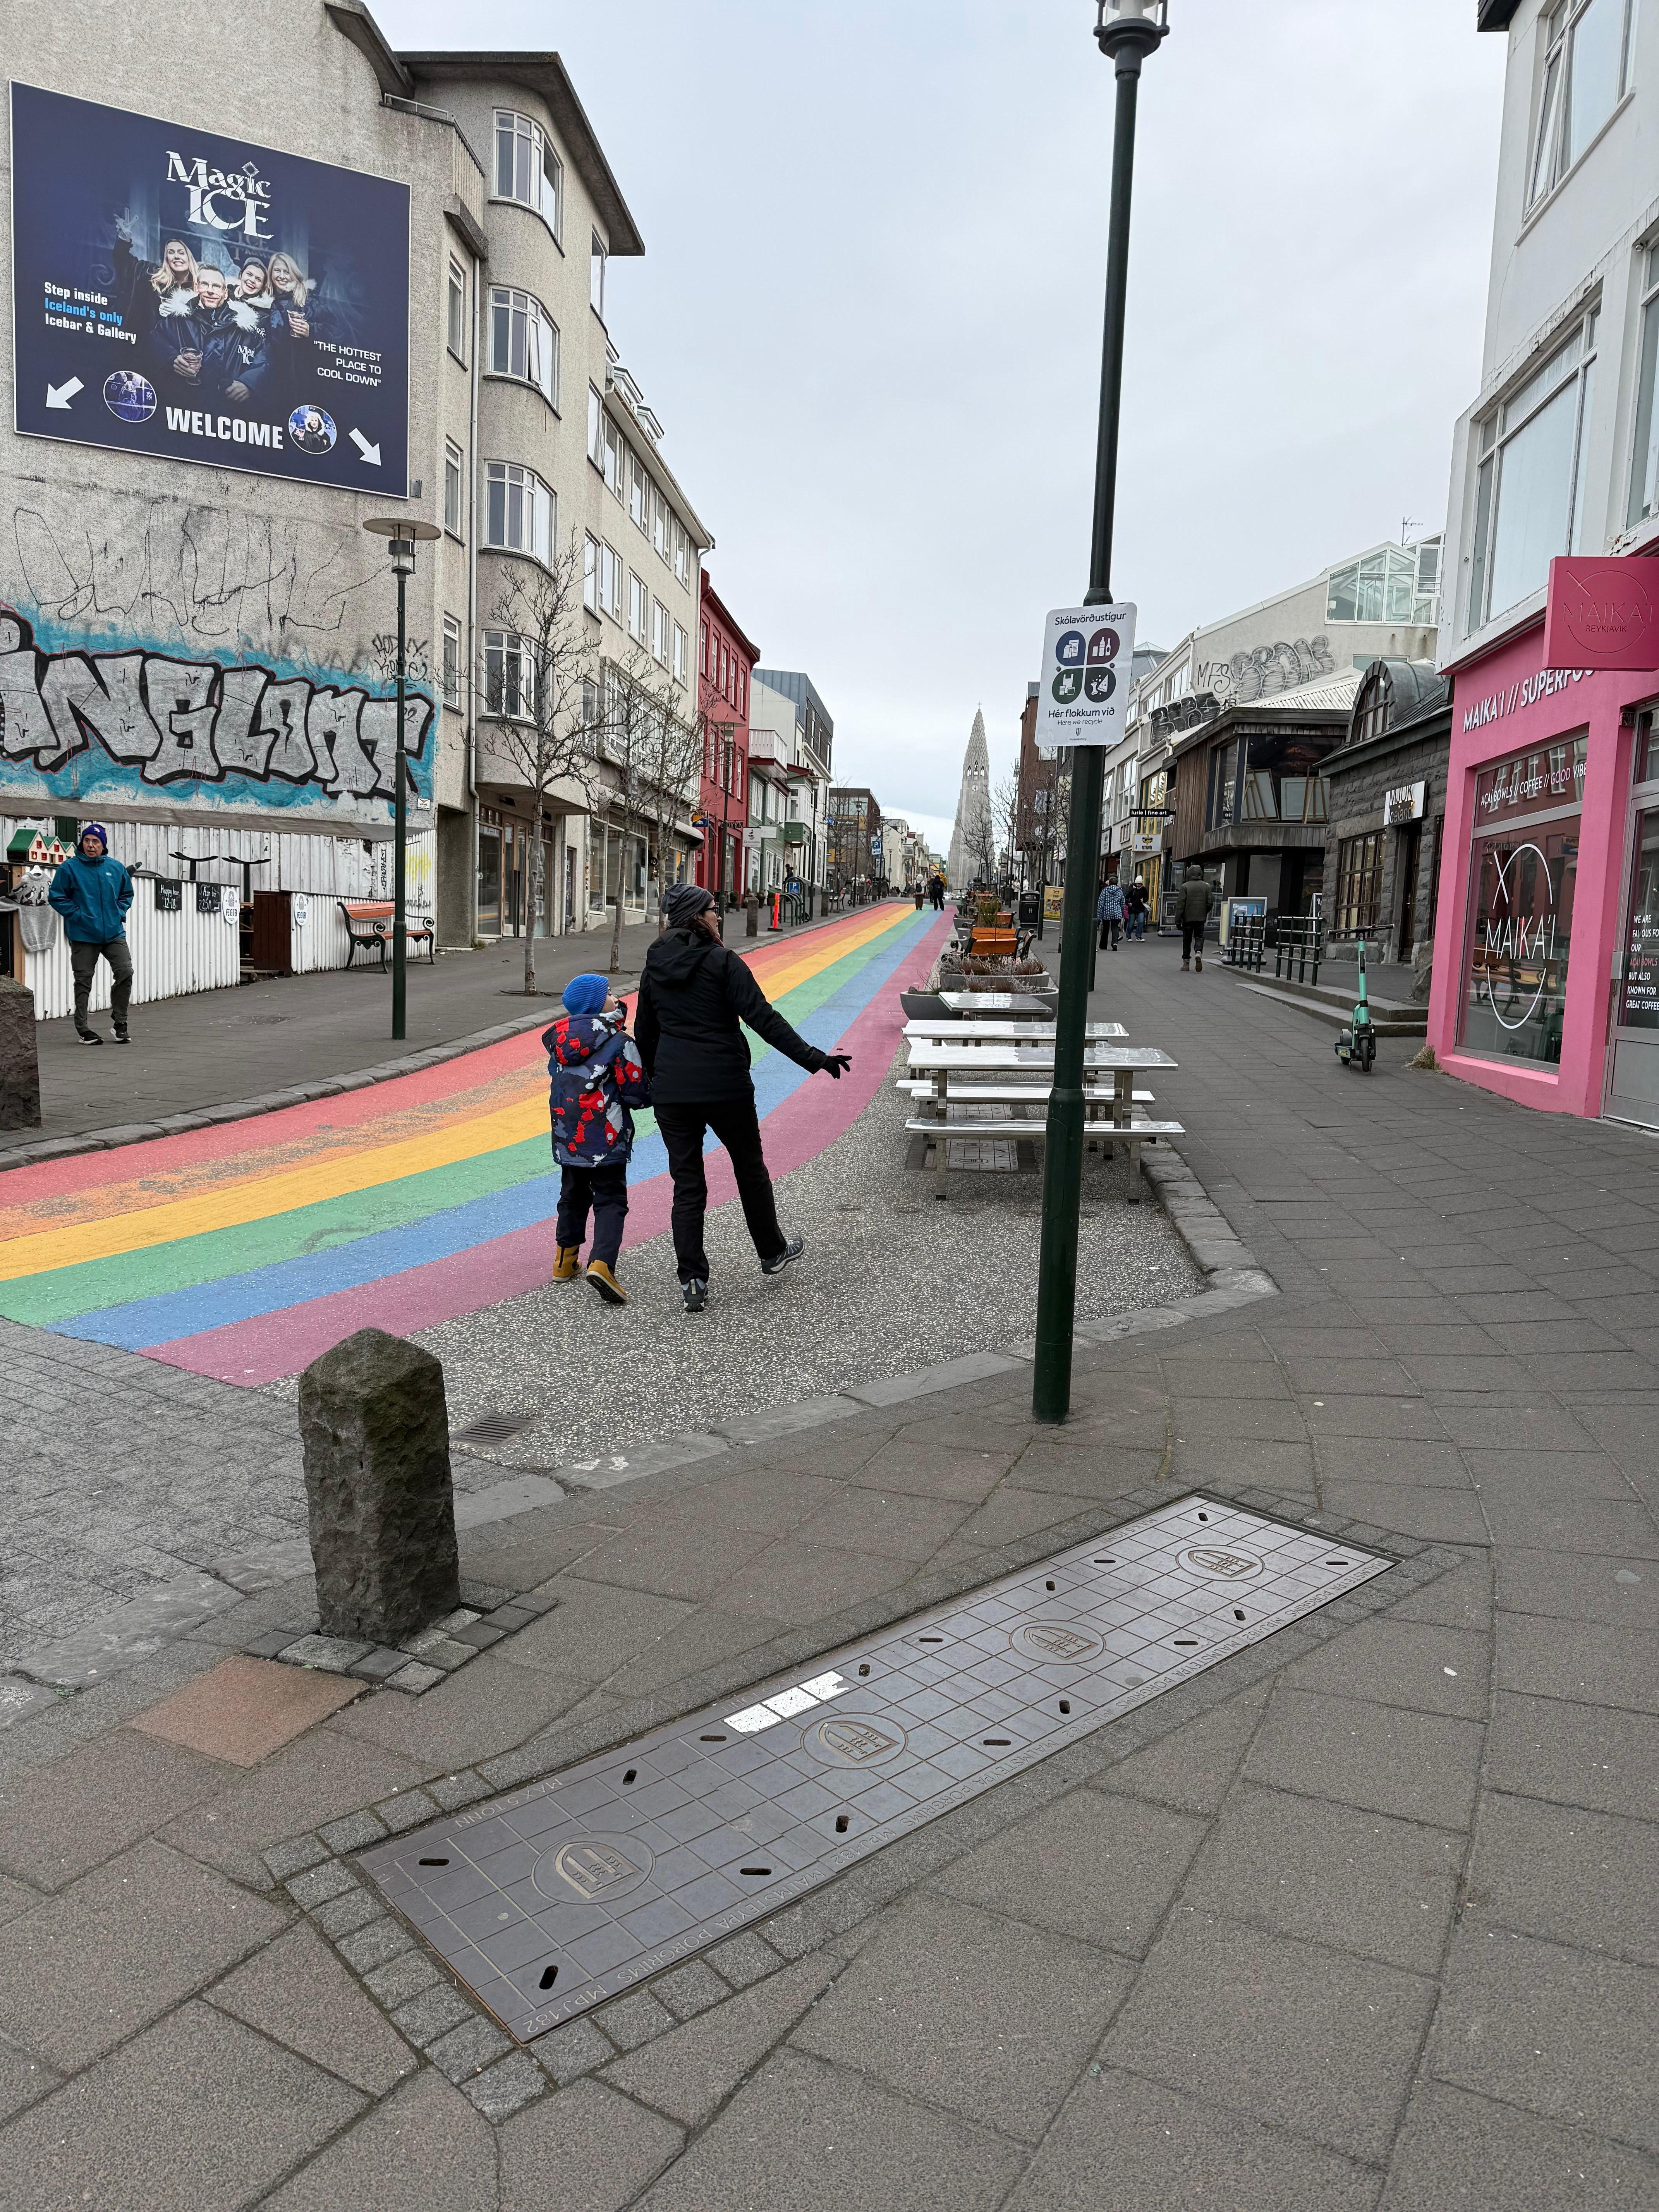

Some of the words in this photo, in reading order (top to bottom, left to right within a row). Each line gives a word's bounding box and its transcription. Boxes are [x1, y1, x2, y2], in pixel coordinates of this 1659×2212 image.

[166, 151, 271, 200] Magic
[184, 184, 274, 239] ICE
[45, 282, 70, 300] Step
[74, 288, 108, 305] inside
[45, 298, 96, 318] Iceland's
[100, 312, 122, 326] only
[45, 313, 82, 331] Icebar
[86, 321, 94, 333] &
[97, 324, 136, 344] Gallery
[314, 340, 336, 353] "THE
[339, 346, 381, 362] HOTTEST
[336, 358, 367, 371] PLACE
[368, 364, 381, 374] TO
[317, 367, 343, 380] COOL
[345, 373, 381, 387] DOWN"
[165, 406, 283, 450] WELCOME
[1055, 611, 1127, 625] Skólavörðustígur
[1586, 625, 1627, 633] REYKJAVÍK
[1463, 690, 1506, 733] MAIKA'I
[1520, 670, 1594, 707] SUPERF
[1048, 709, 1064, 718] Hér
[1065, 709, 1100, 717] flokkum
[1102, 707, 1115, 716] við
[1494, 785, 1513, 802] BOWLS
[1520, 776, 1543, 794] COFFEE
[1551, 768, 1571, 785] GOOD
[1633, 915, 1641, 924] WE
[1642, 914, 1652, 923] ARE
[1484, 913, 1556, 960] MAIKA'I
[1631, 943, 1641, 952] OUR
[1641, 958, 1658, 967] BOWLS
[1628, 972, 1638, 981] BUT
[1638, 972, 1650, 981] ALSO
[1627, 986, 1646, 995] KNOWN
[1646, 986, 1657, 995] FOR
[1626, 1000, 1640, 1009] GREAT
[1132, 1518, 1158, 1529] MAX
[1099, 1531, 1128, 1544] TONN
[971, 1587, 1000, 1600] MAX
[931, 1603, 965, 1618] TONN
[773, 1672, 808, 1688] MAX
[762, 1686, 773, 1694] 5
[722, 1693, 761, 1711] TONN
[521, 1779, 563, 1800] MAX
[507, 1796, 519, 1805] 5
[455, 1804, 505, 1828] TONN
